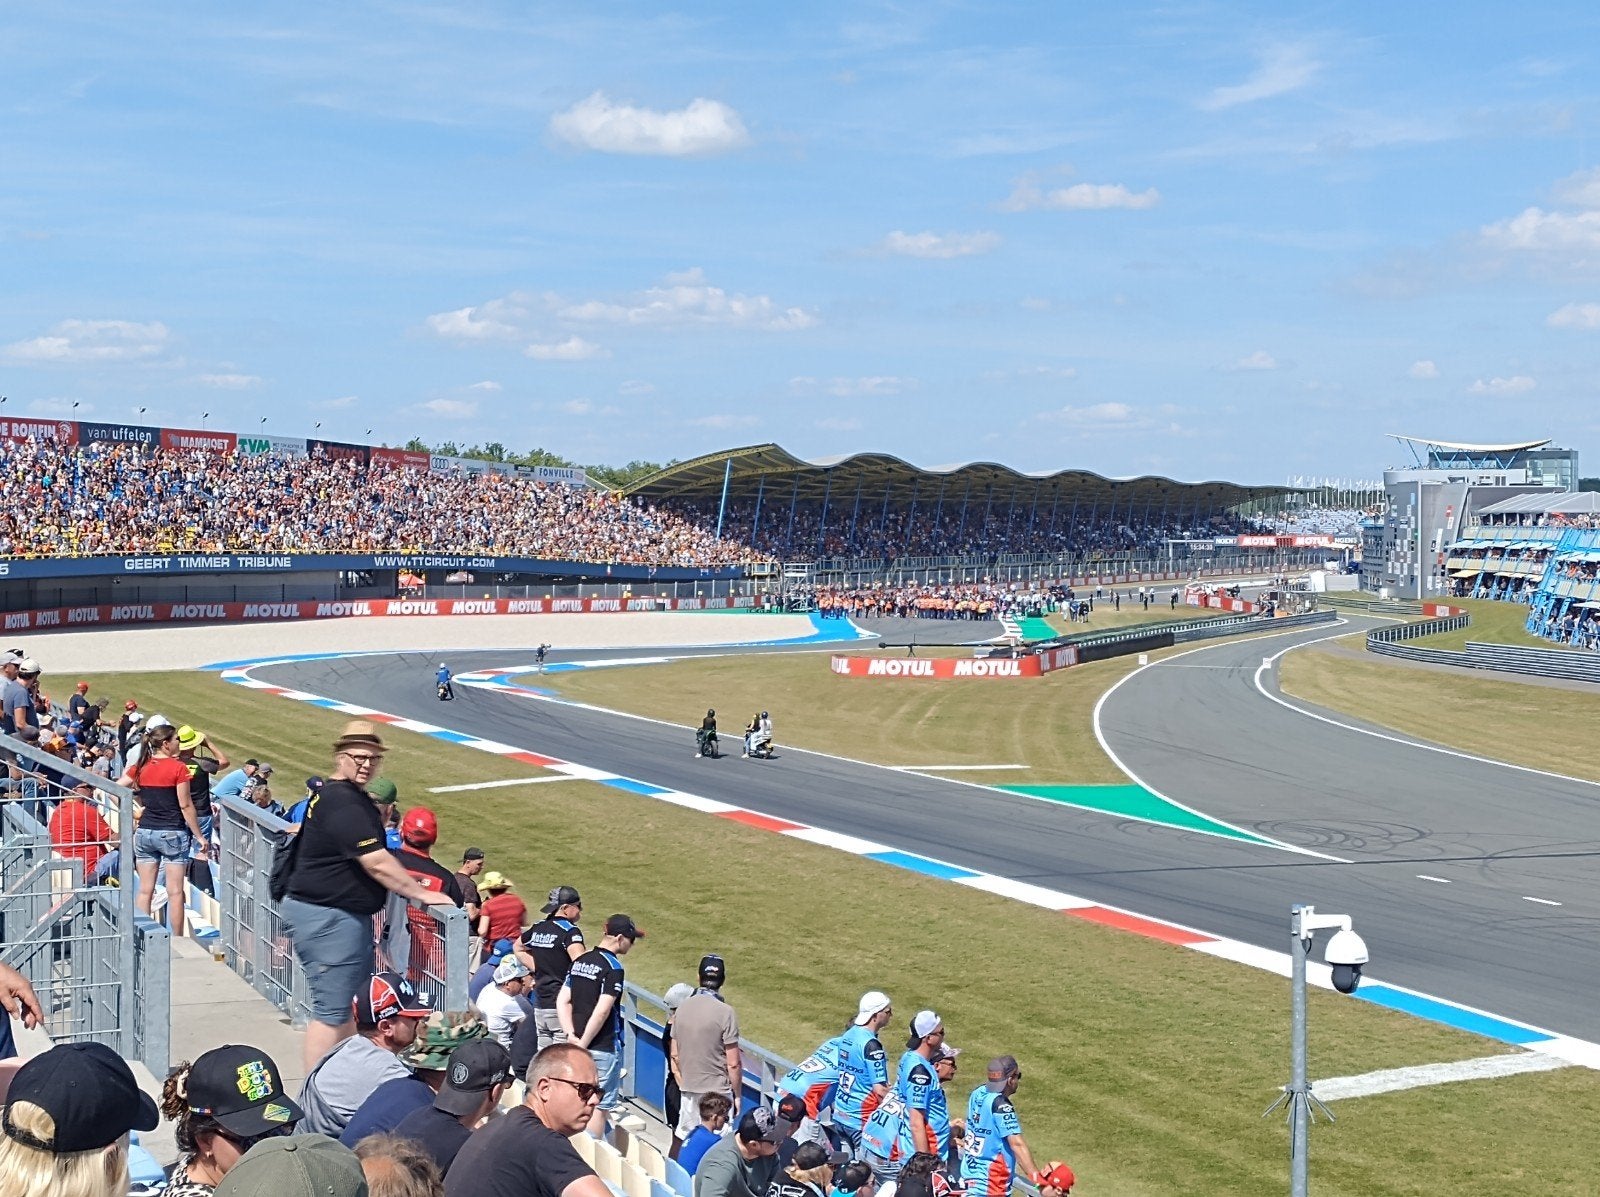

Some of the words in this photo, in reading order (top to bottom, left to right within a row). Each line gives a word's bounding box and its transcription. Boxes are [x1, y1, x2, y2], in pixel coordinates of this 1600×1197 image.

[88, 428, 107, 439] van
[113, 428, 152, 442] uffelen
[238, 438, 271, 453] TVM
[125, 558, 171, 570] GEERT
[178, 557, 230, 569] TIMMER
[238, 556, 292, 568] TRIBUNE
[374, 556, 495, 568] WWW.TTCIRCUIT.COM
[243, 604, 299, 617] MOTUL
[317, 602, 371, 616] MOTUL
[387, 601, 437, 615] MOTUL
[452, 601, 496, 614] MOTUL
[508, 601, 542, 613] MOTUL
[552, 600, 583, 612] MOTUL
[591, 600, 621, 612] MOTUL
[678, 599, 702, 610] MOTUL
[705, 598, 727, 609] MOTUL
[68, 608, 99, 623] MOTUL
[111, 606, 154, 620] MOTUL
[171, 604, 226, 618] MOTUL
[5, 613, 30, 629] MOTUL
[36, 611, 60, 626] MOTUL
[868, 659, 934, 676] MOTUL
[954, 660, 1021, 676] MOTUL
